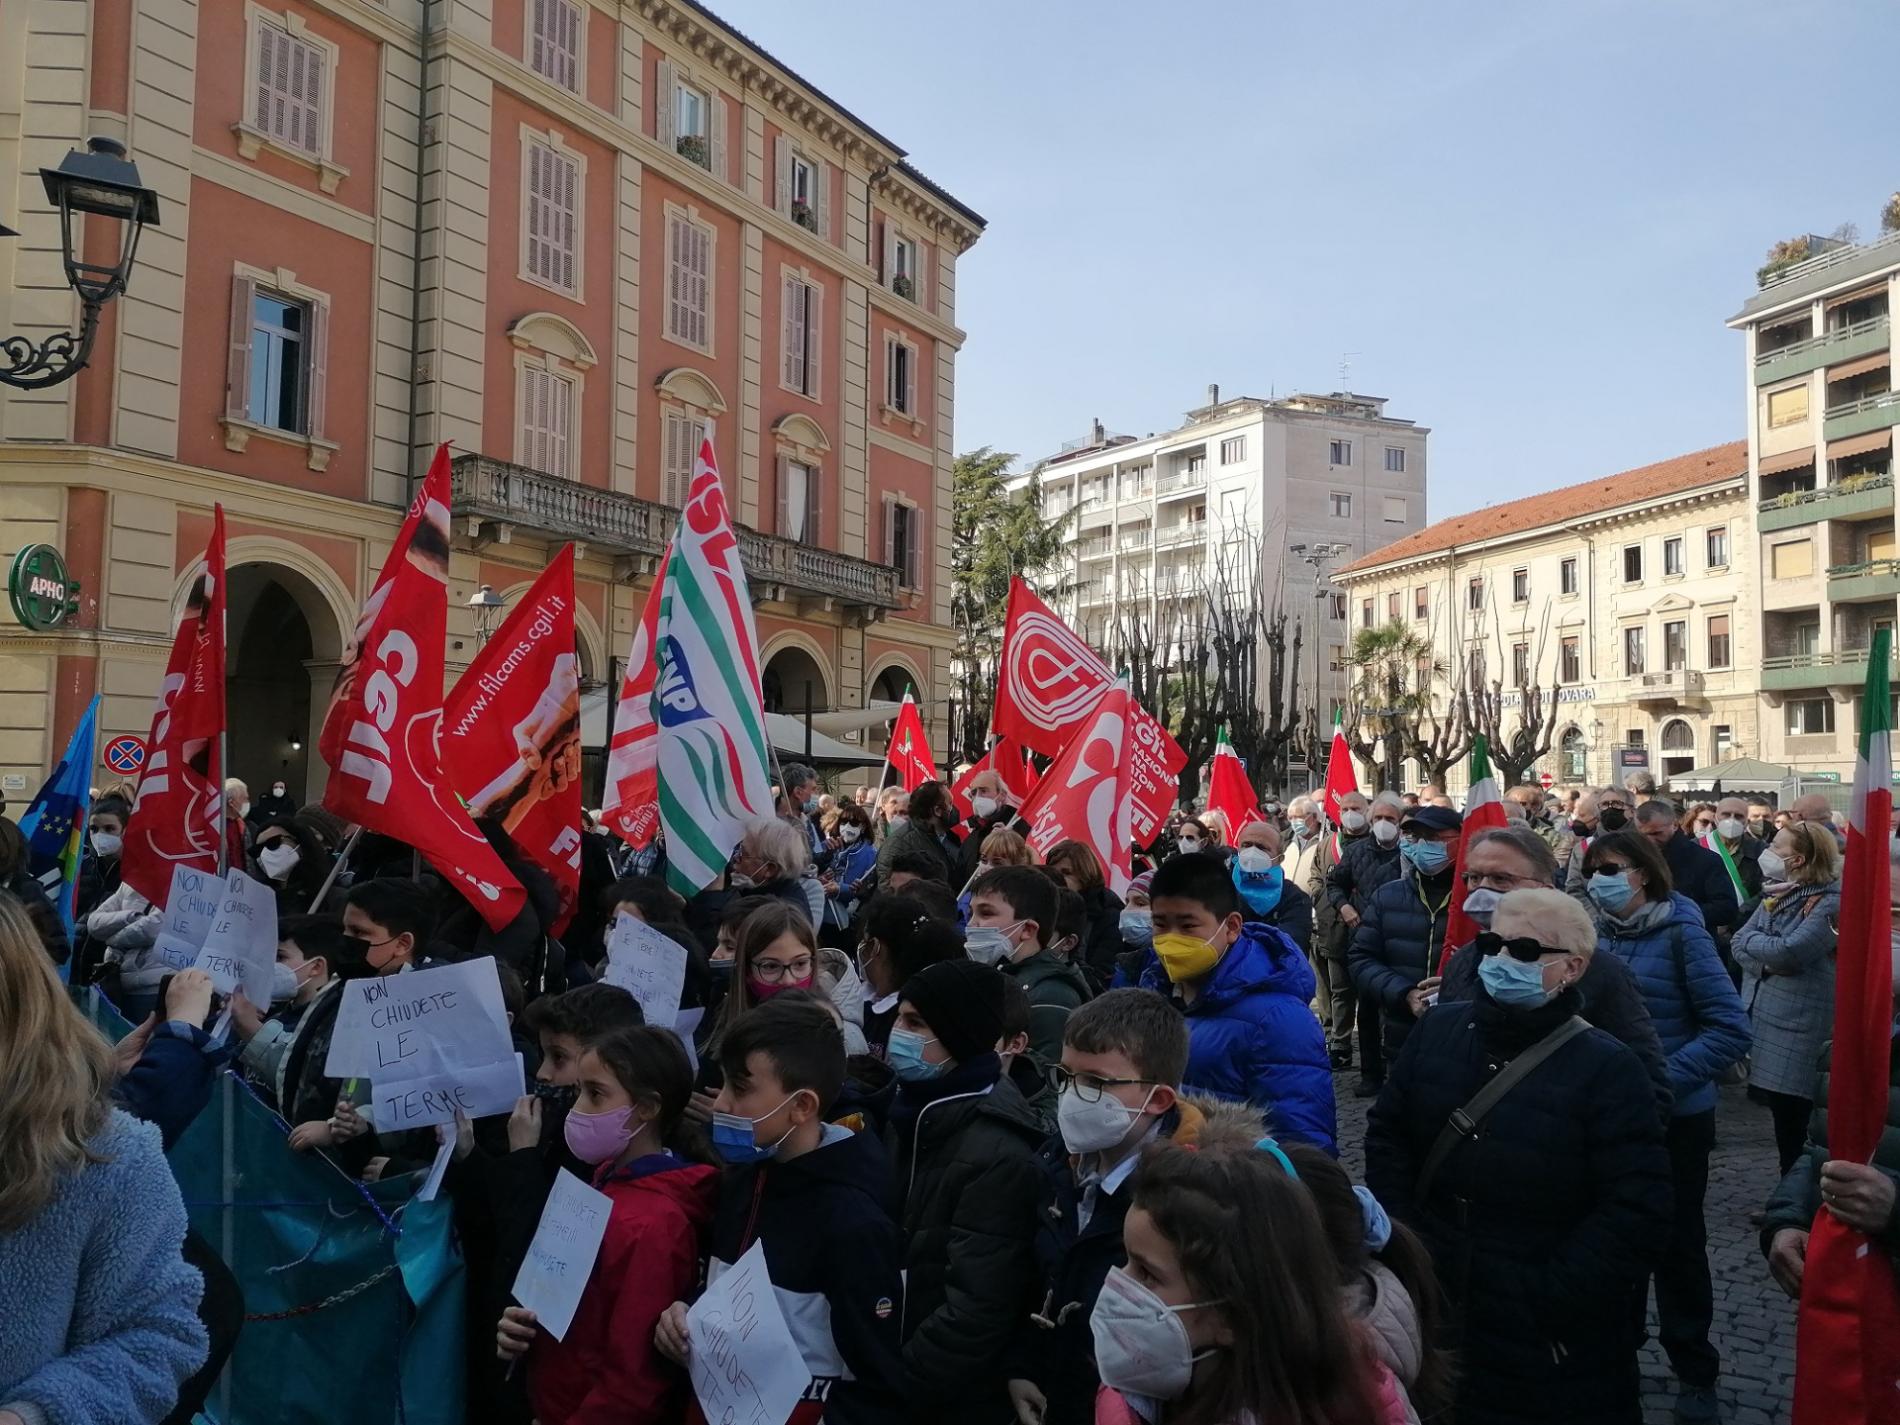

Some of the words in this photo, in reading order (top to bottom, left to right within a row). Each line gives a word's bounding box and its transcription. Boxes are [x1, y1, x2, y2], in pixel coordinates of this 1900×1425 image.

[453, 595, 567, 737] www.filcams.cgil.it
[1558, 687, 1596, 702] OVARA
[1131, 753, 1148, 773] NA
[1131, 740, 1176, 788] RAZIONE
[1131, 806, 1156, 837] TE
[177, 871, 204, 893] NON
[172, 917, 189, 934] LE
[215, 920, 232, 934] LE
[162, 946, 197, 970] TERM
[207, 955, 247, 980] TERME
[362, 977, 389, 1005] NON
[371, 991, 457, 1029] CHIUDETE
[376, 1030, 419, 1069] LE
[385, 1085, 476, 1122] TERME
[728, 1267, 759, 1342] NON
